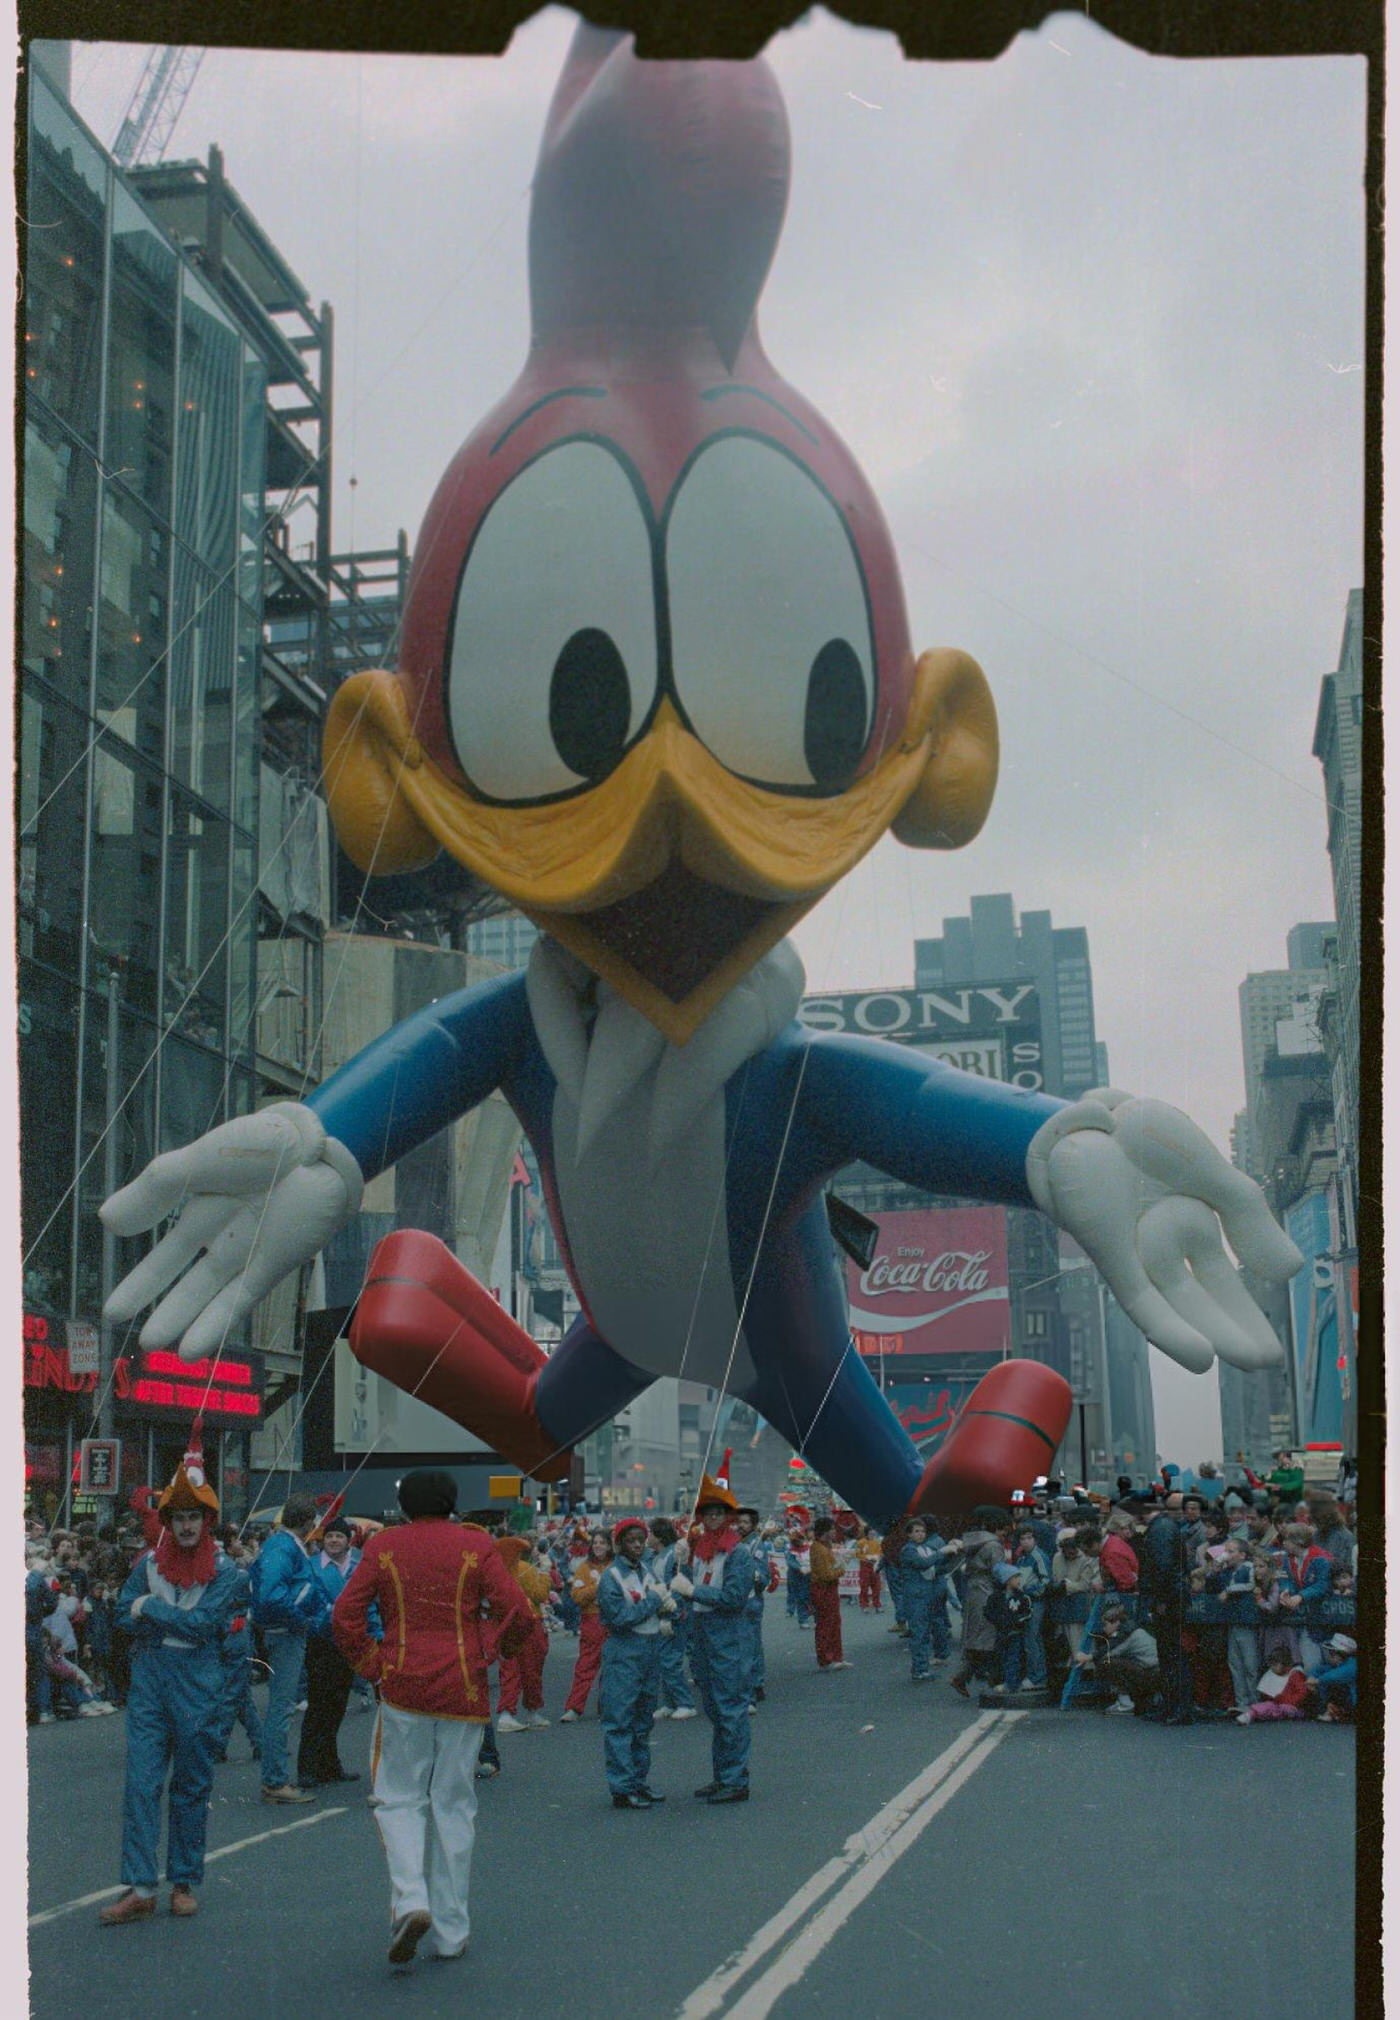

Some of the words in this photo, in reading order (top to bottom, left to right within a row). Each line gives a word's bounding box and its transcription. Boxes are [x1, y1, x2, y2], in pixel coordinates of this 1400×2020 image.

[798, 985, 1035, 1032] SONY
[860, 1251, 994, 1296] Coca-Cola
[897, 1246, 925, 1258] Enjoy
